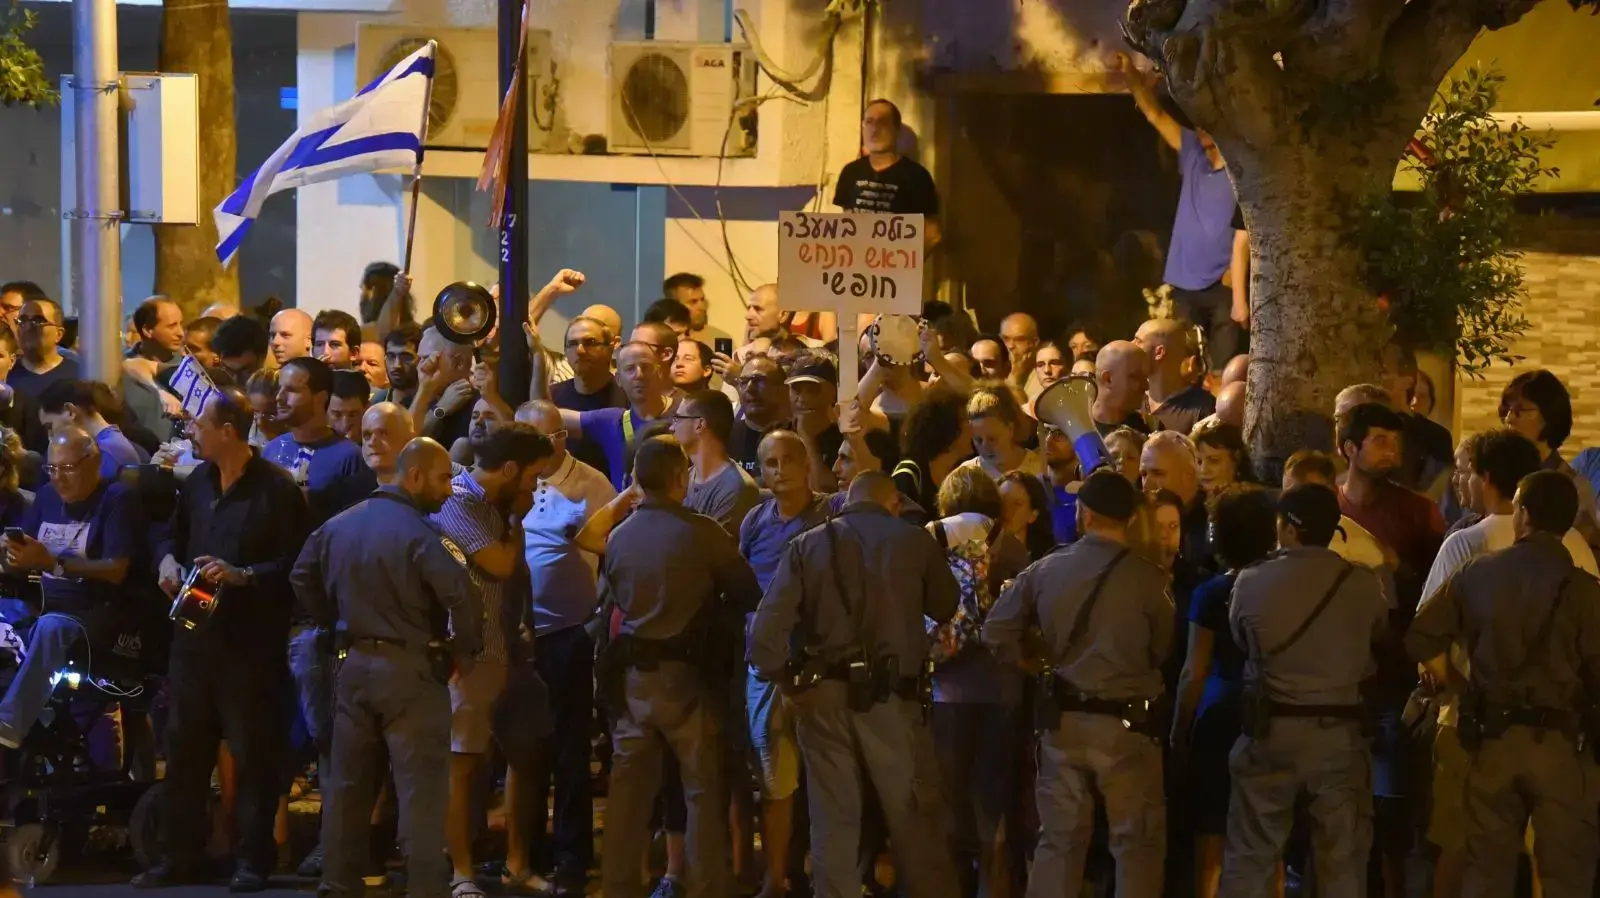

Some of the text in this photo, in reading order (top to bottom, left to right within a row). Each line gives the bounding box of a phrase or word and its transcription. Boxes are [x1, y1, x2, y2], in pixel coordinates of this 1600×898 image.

[783, 213, 917, 241] כולם במעצר
[798, 242, 917, 269] וראש הנחש
[822, 271, 897, 299] חופשי
